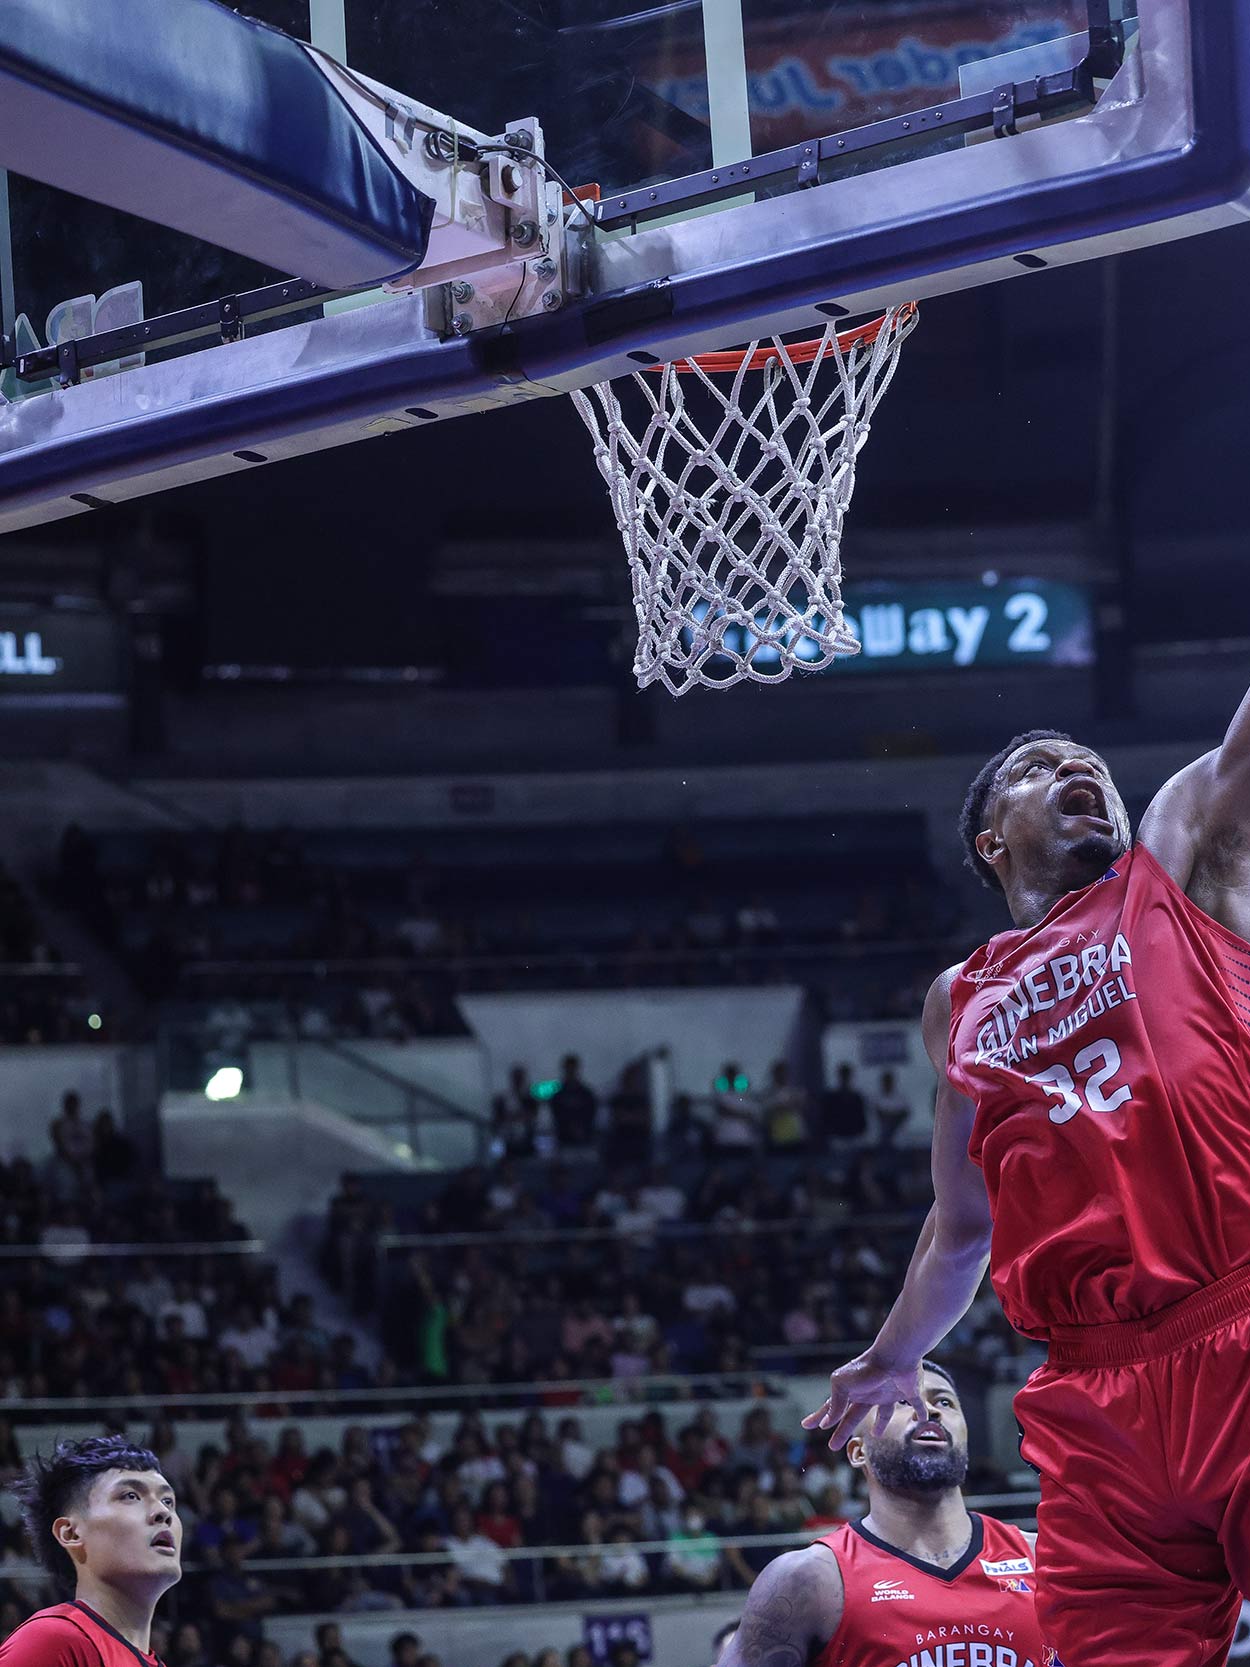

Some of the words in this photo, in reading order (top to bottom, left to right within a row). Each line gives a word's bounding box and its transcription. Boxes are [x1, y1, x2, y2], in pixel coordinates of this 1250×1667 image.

[1004, 591, 1053, 653] 2
[974, 932, 1133, 1066] GINEBRA
[988, 1034, 1040, 1070] SAN
[1047, 975, 1137, 1046] MIGUEL
[1024, 1037, 1133, 1126] 32
[871, 1594, 915, 1602] BALANCE
[915, 1624, 1015, 1646] BARANGAY
